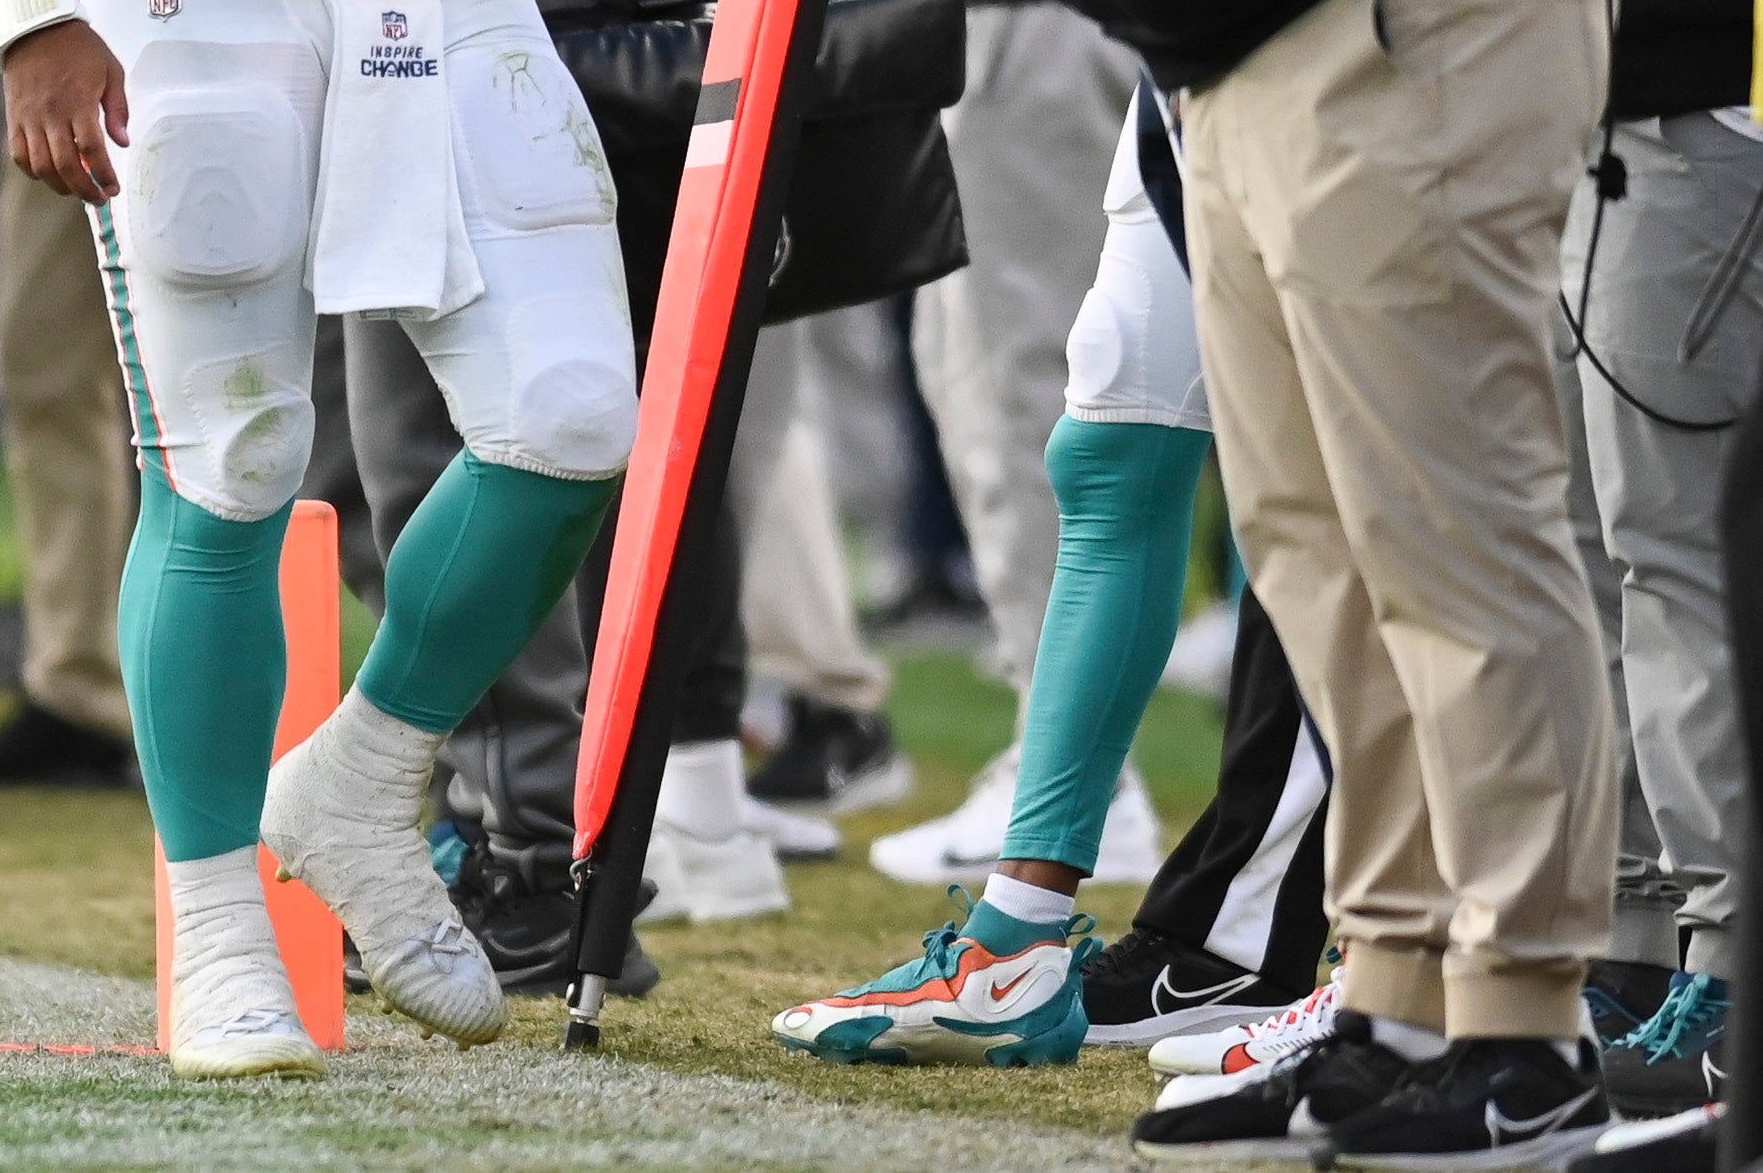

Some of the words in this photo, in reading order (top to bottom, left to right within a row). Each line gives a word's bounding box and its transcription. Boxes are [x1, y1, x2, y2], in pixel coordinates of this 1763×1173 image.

[385, 24, 408, 39] NFL
[370, 45, 423, 59] INSPIRE
[361, 58, 439, 78] CHANGE
